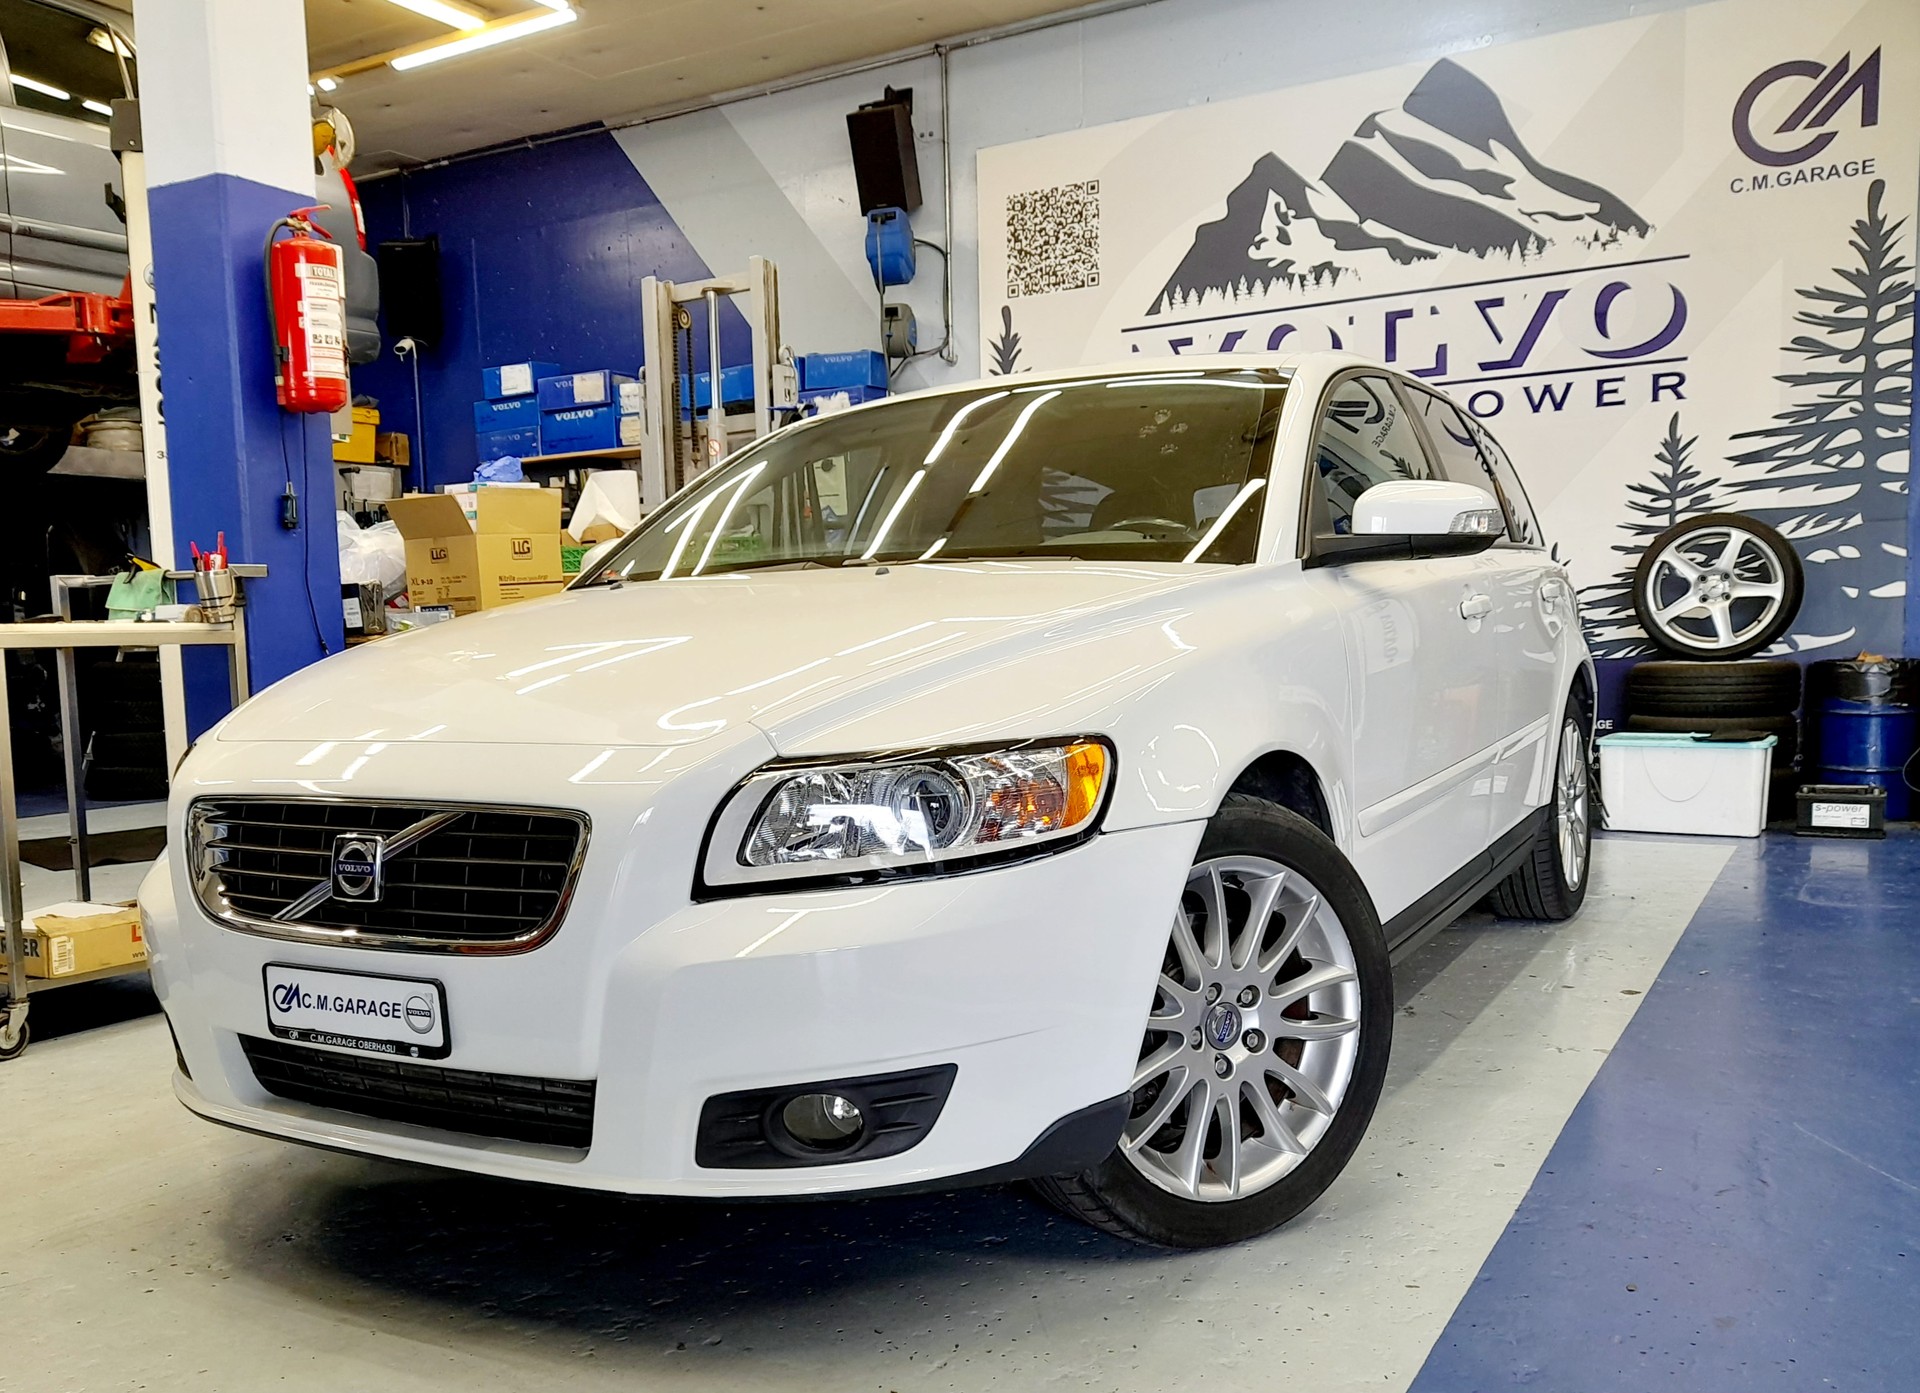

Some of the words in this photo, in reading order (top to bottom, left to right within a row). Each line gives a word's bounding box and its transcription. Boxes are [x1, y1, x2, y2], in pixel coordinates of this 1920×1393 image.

[1730, 158, 1876, 193] C.M.GARAGE
[1467, 372, 1688, 419] OWER
[491, 401, 521, 412] VOLVO
[554, 409, 594, 421] VOLVO
[431, 549, 447, 560] LLG
[512, 540, 531, 555] LLG
[338, 862, 371, 873] VOLVO
[302, 992, 402, 1019] C.M.GARAGE
[310, 1033, 356, 1048] C.M.GARAGE
[358, 1040, 396, 1053] OBERHASLI
